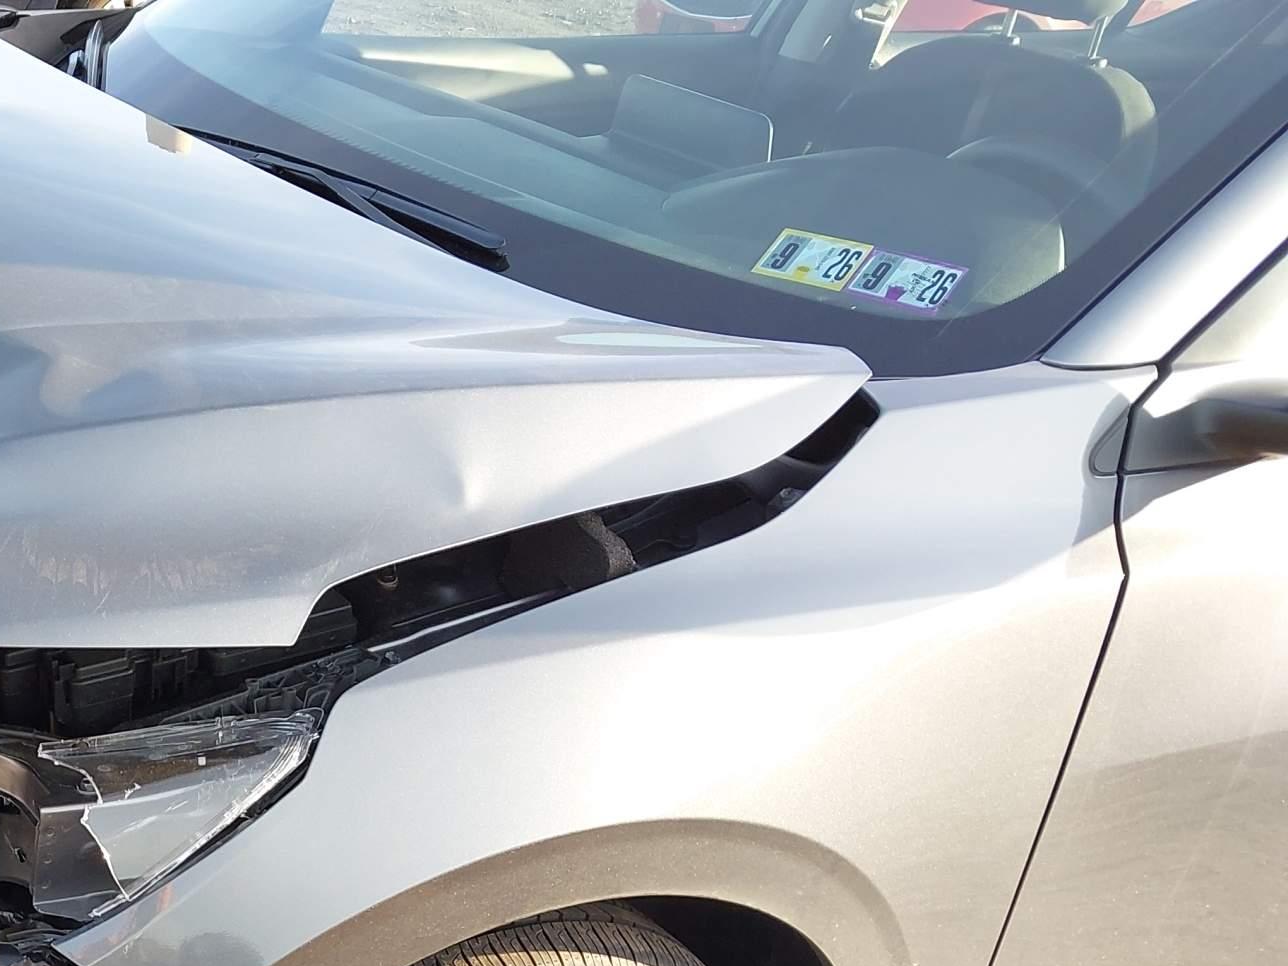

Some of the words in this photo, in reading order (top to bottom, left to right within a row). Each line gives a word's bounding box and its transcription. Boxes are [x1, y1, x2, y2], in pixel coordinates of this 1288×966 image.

[771, 242, 800, 269] 9
[822, 248, 863, 281] 26
[862, 262, 892, 290] 9
[916, 270, 958, 305] 26
